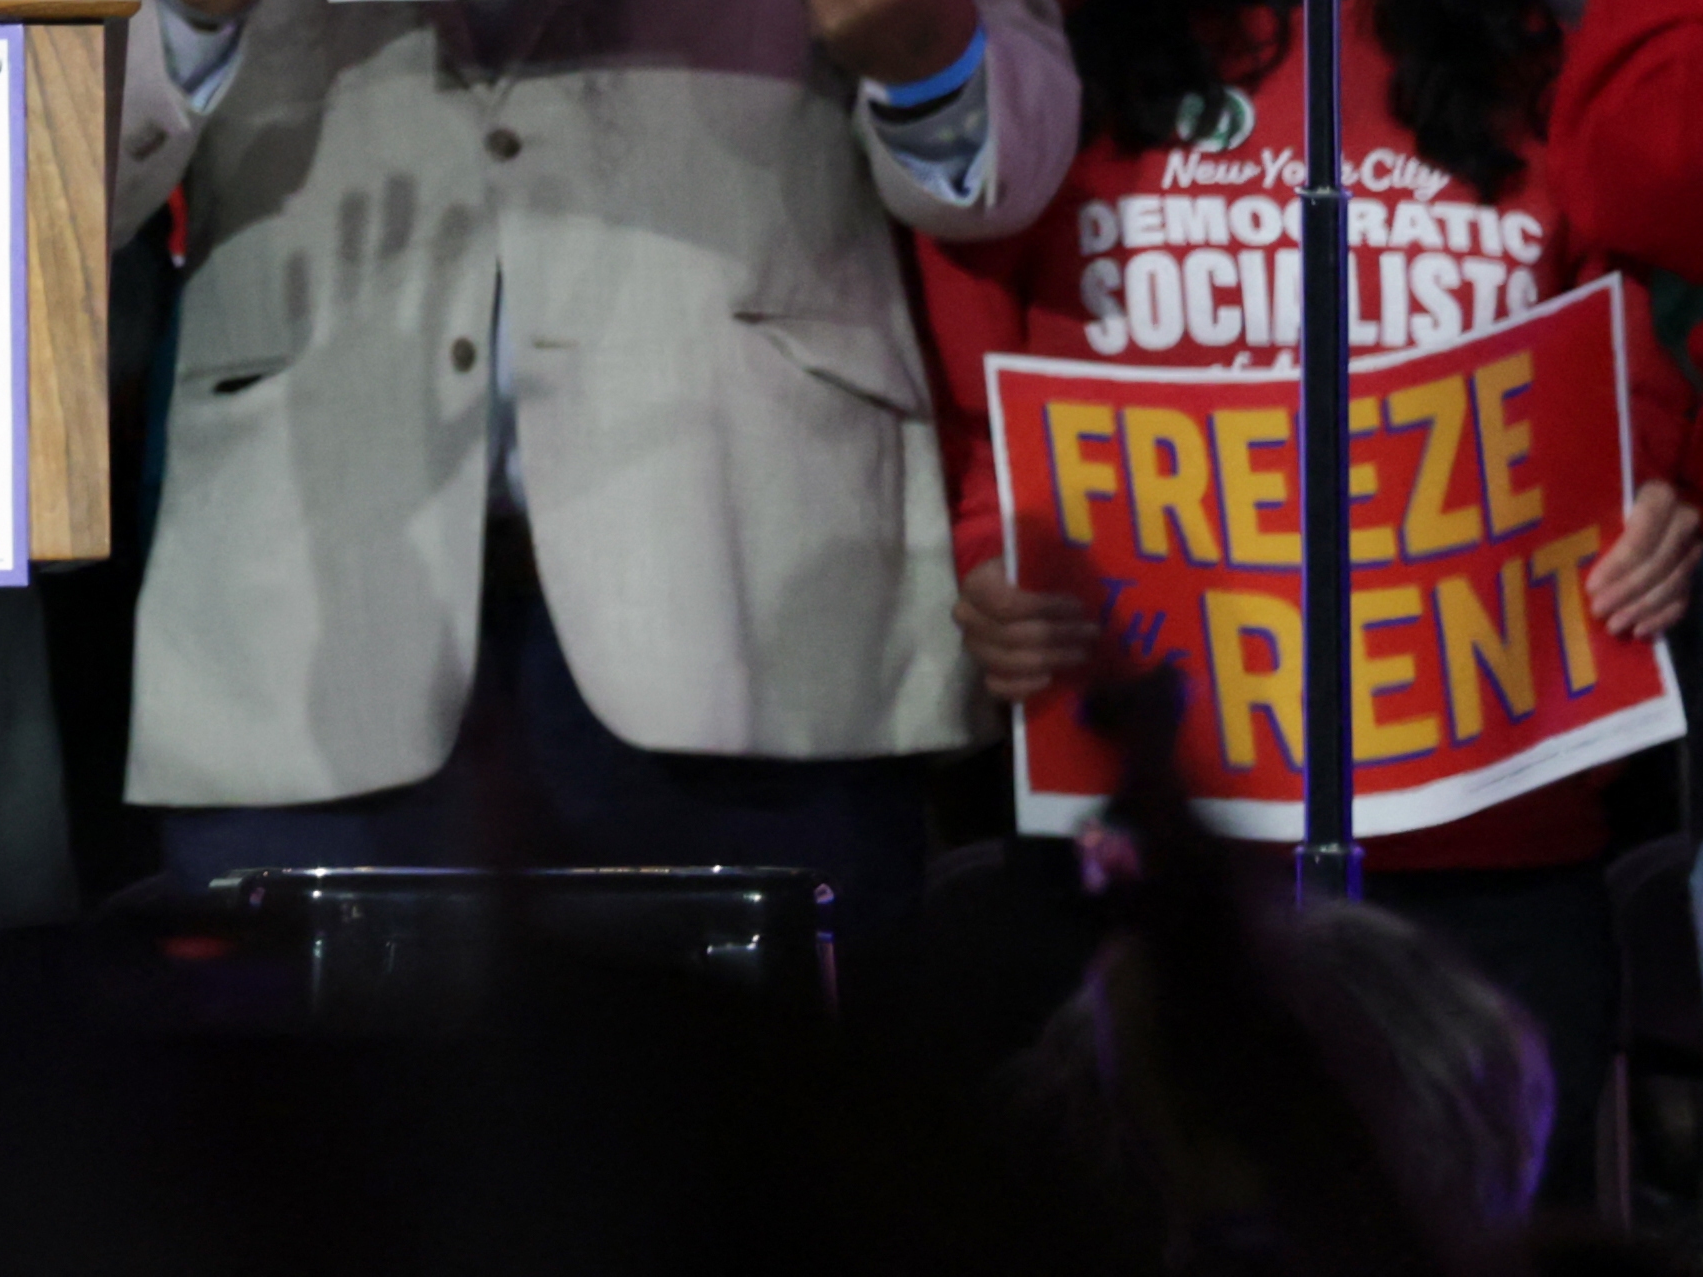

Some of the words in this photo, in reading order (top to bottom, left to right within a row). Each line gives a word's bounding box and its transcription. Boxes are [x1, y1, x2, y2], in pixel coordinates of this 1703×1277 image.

[1160, 147, 1260, 190] New
[1358, 146, 1452, 202] City
[1045, 350, 1546, 570] FREEZE
[1201, 526, 1601, 774] RENT
